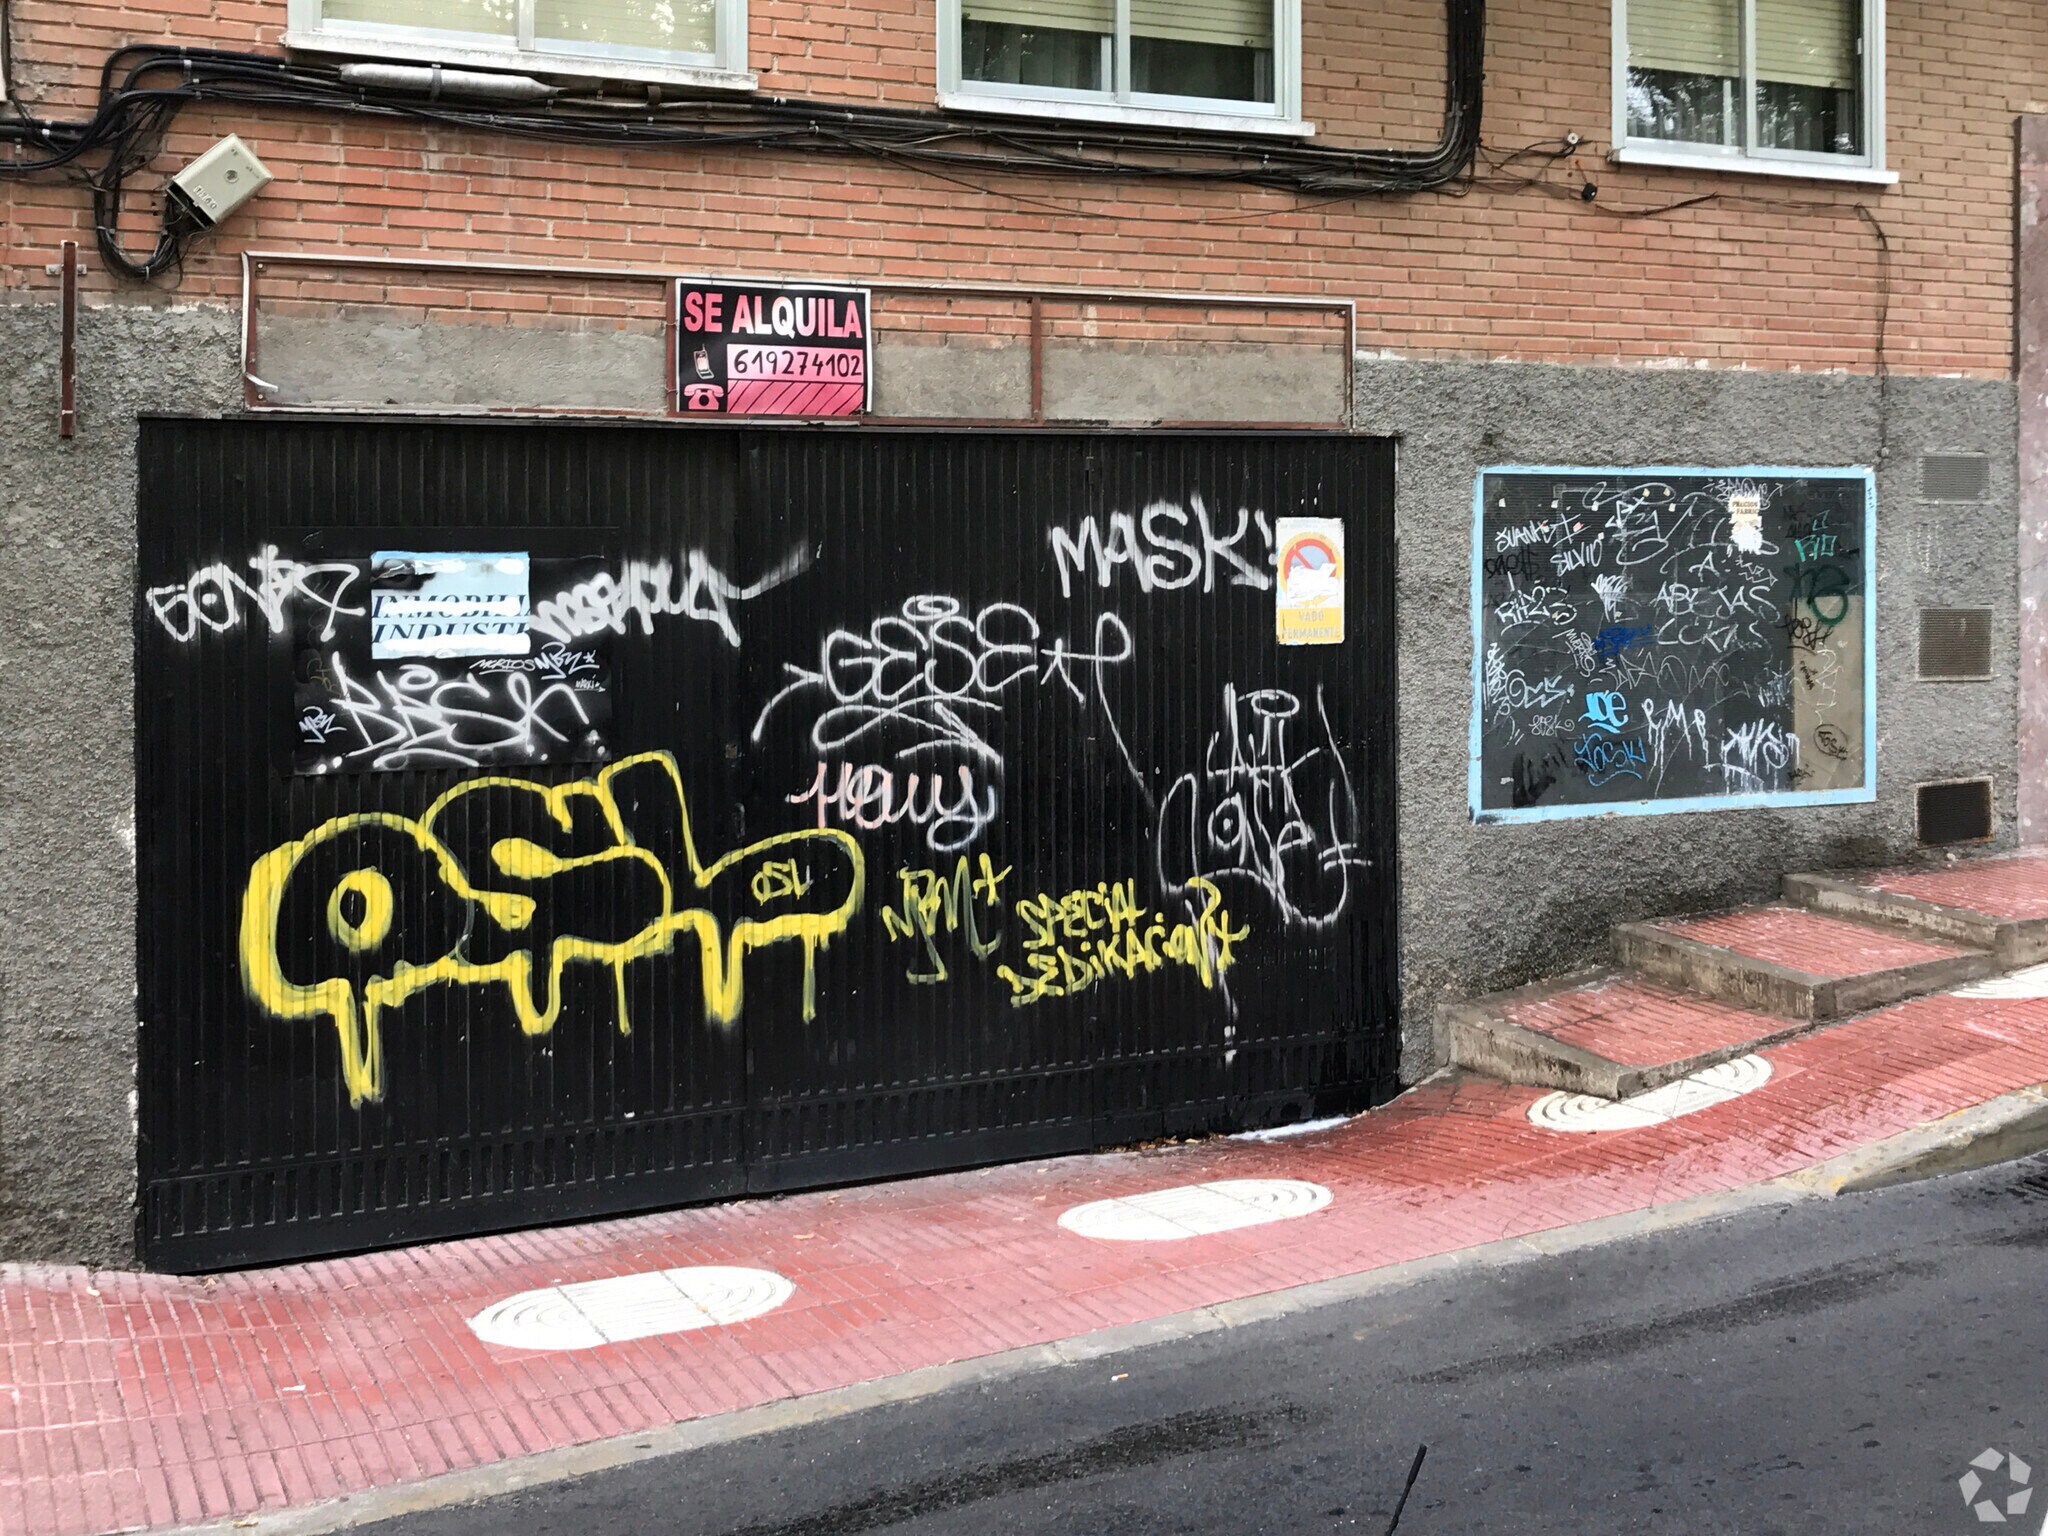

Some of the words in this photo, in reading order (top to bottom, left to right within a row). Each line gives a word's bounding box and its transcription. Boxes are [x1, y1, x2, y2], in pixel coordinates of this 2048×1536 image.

[684, 291, 723, 333] SE
[731, 294, 863, 340] ALQUILA
[734, 349, 863, 378] 619274102
[1298, 610, 1325, 621] VADO
